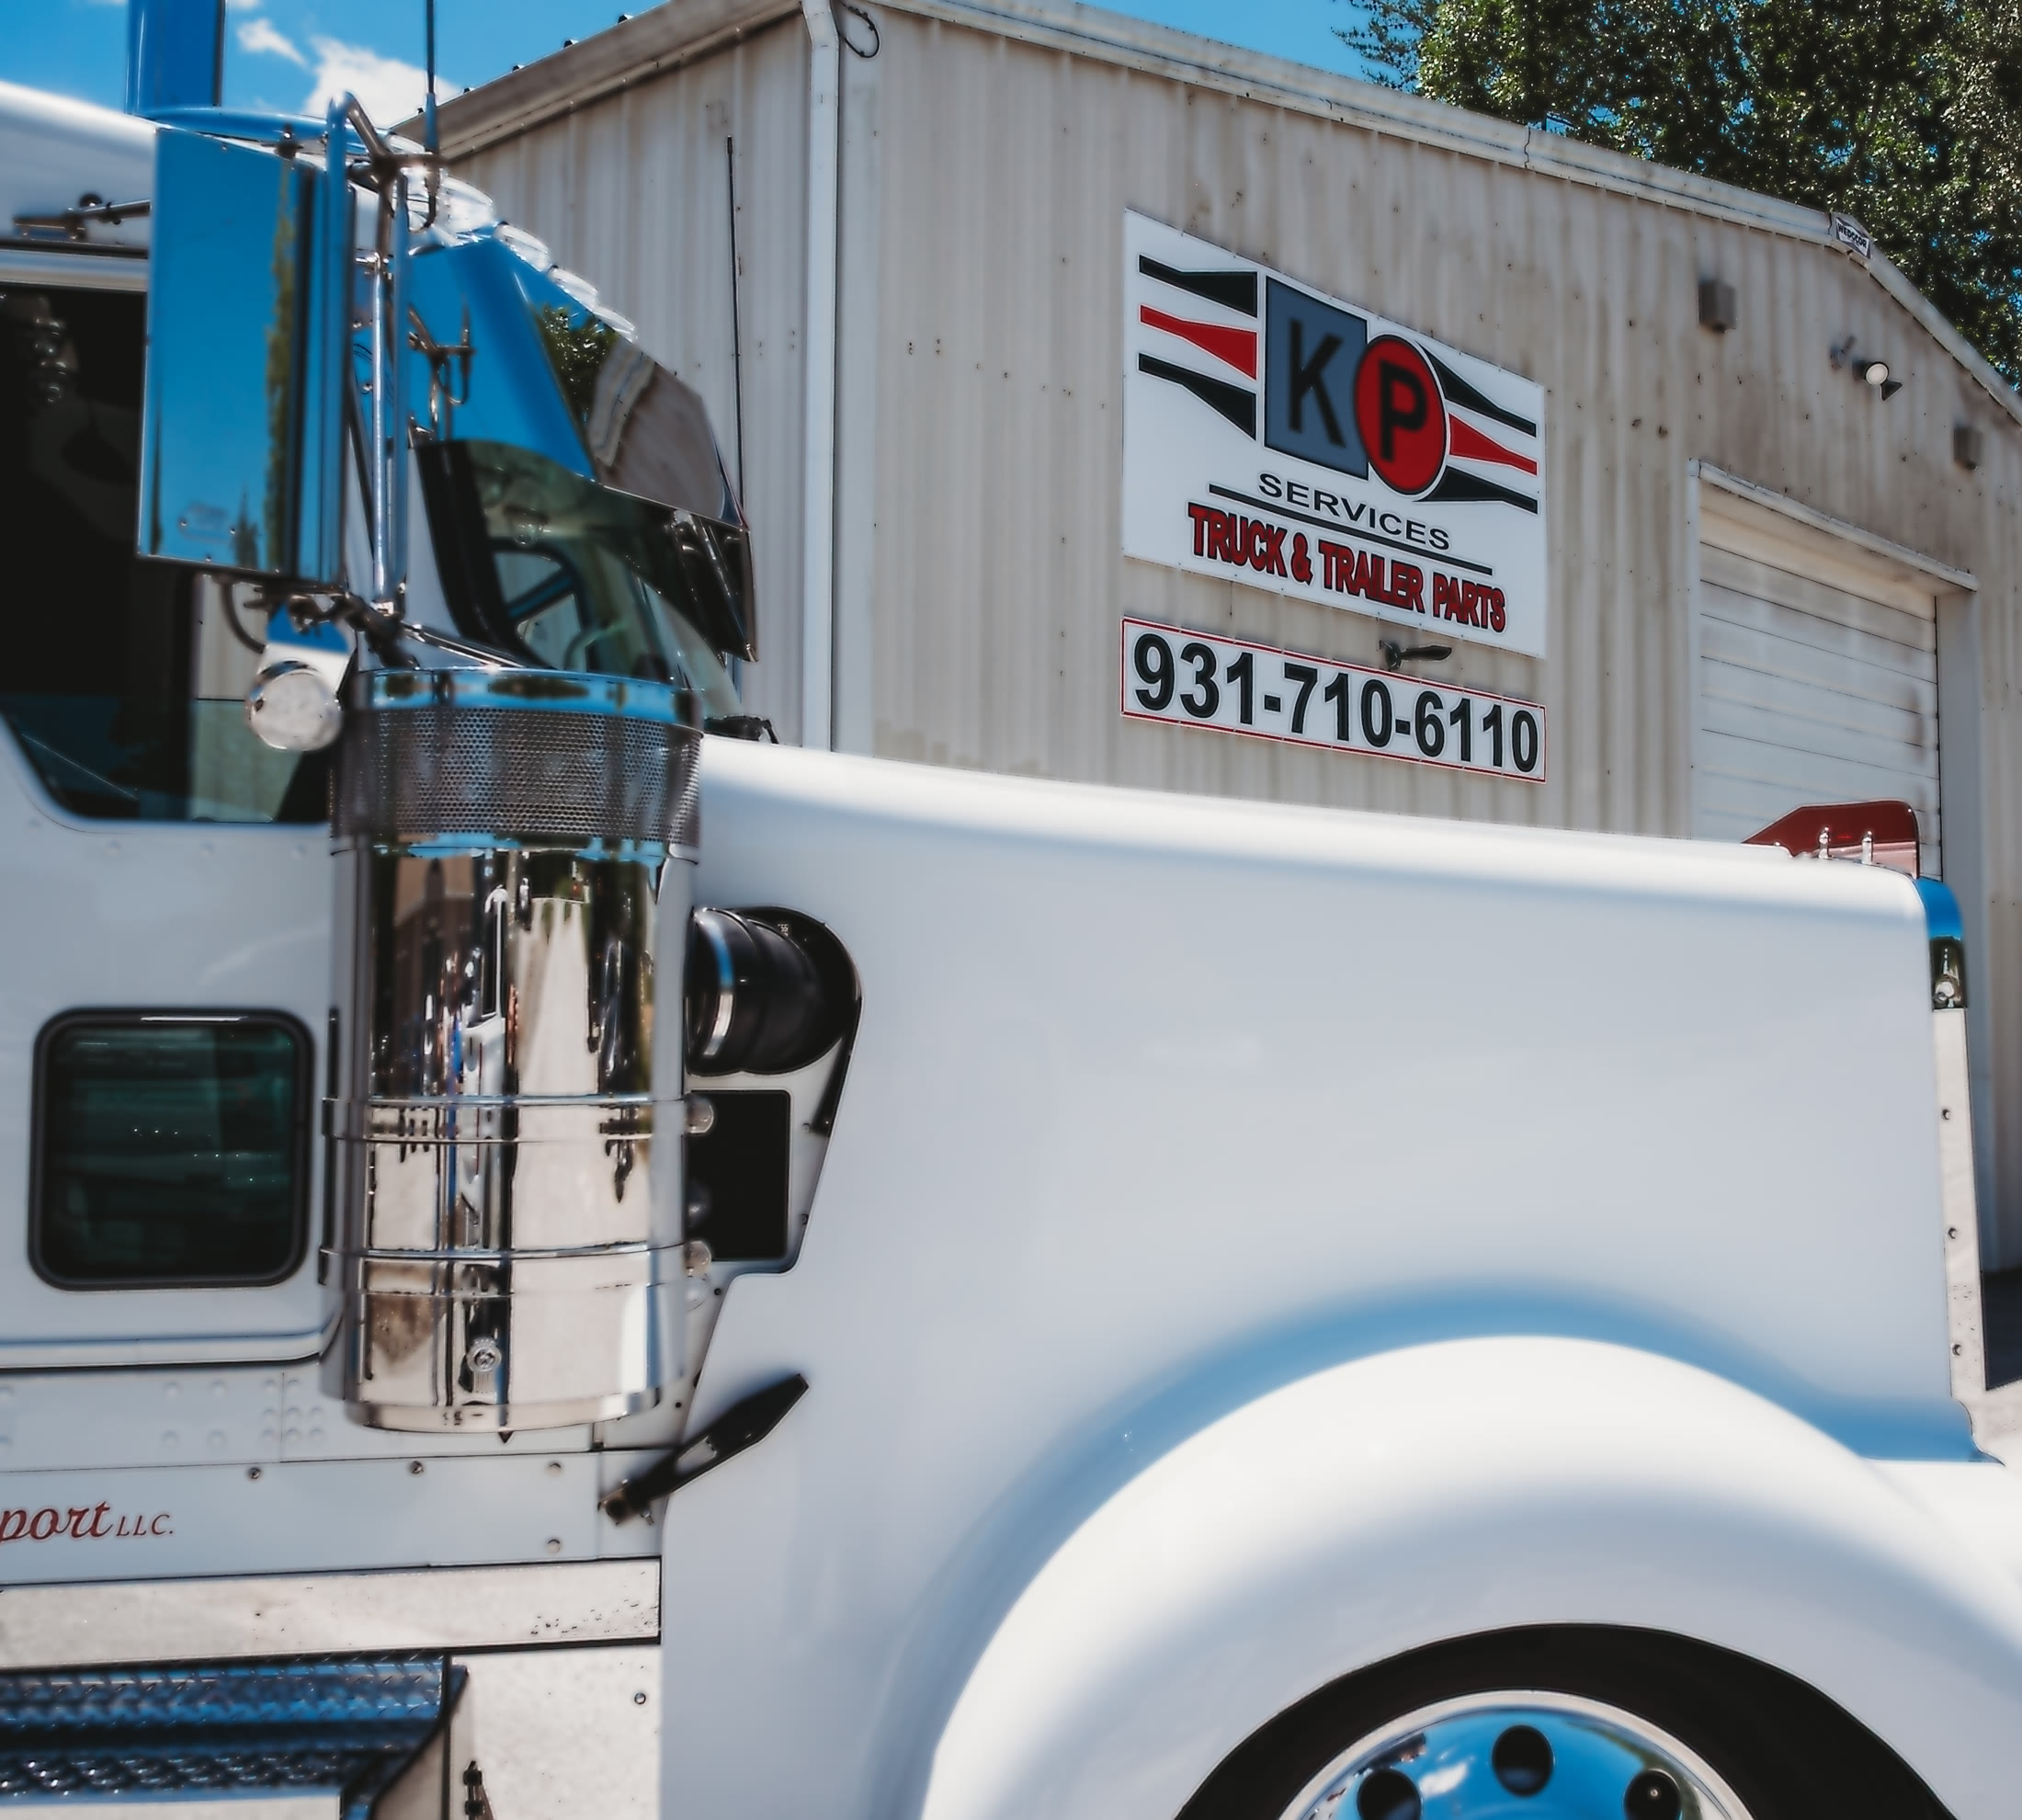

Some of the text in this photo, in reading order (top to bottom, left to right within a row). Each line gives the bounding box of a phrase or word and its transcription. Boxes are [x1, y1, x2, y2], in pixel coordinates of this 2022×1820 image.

[1258, 473, 1450, 551] SERVICES
[1187, 501, 1506, 633] TRUCK & TRAILER PARTS
[1133, 632, 1539, 773] 931-710-6110
[116, 1514, 174, 1536] LLC.
